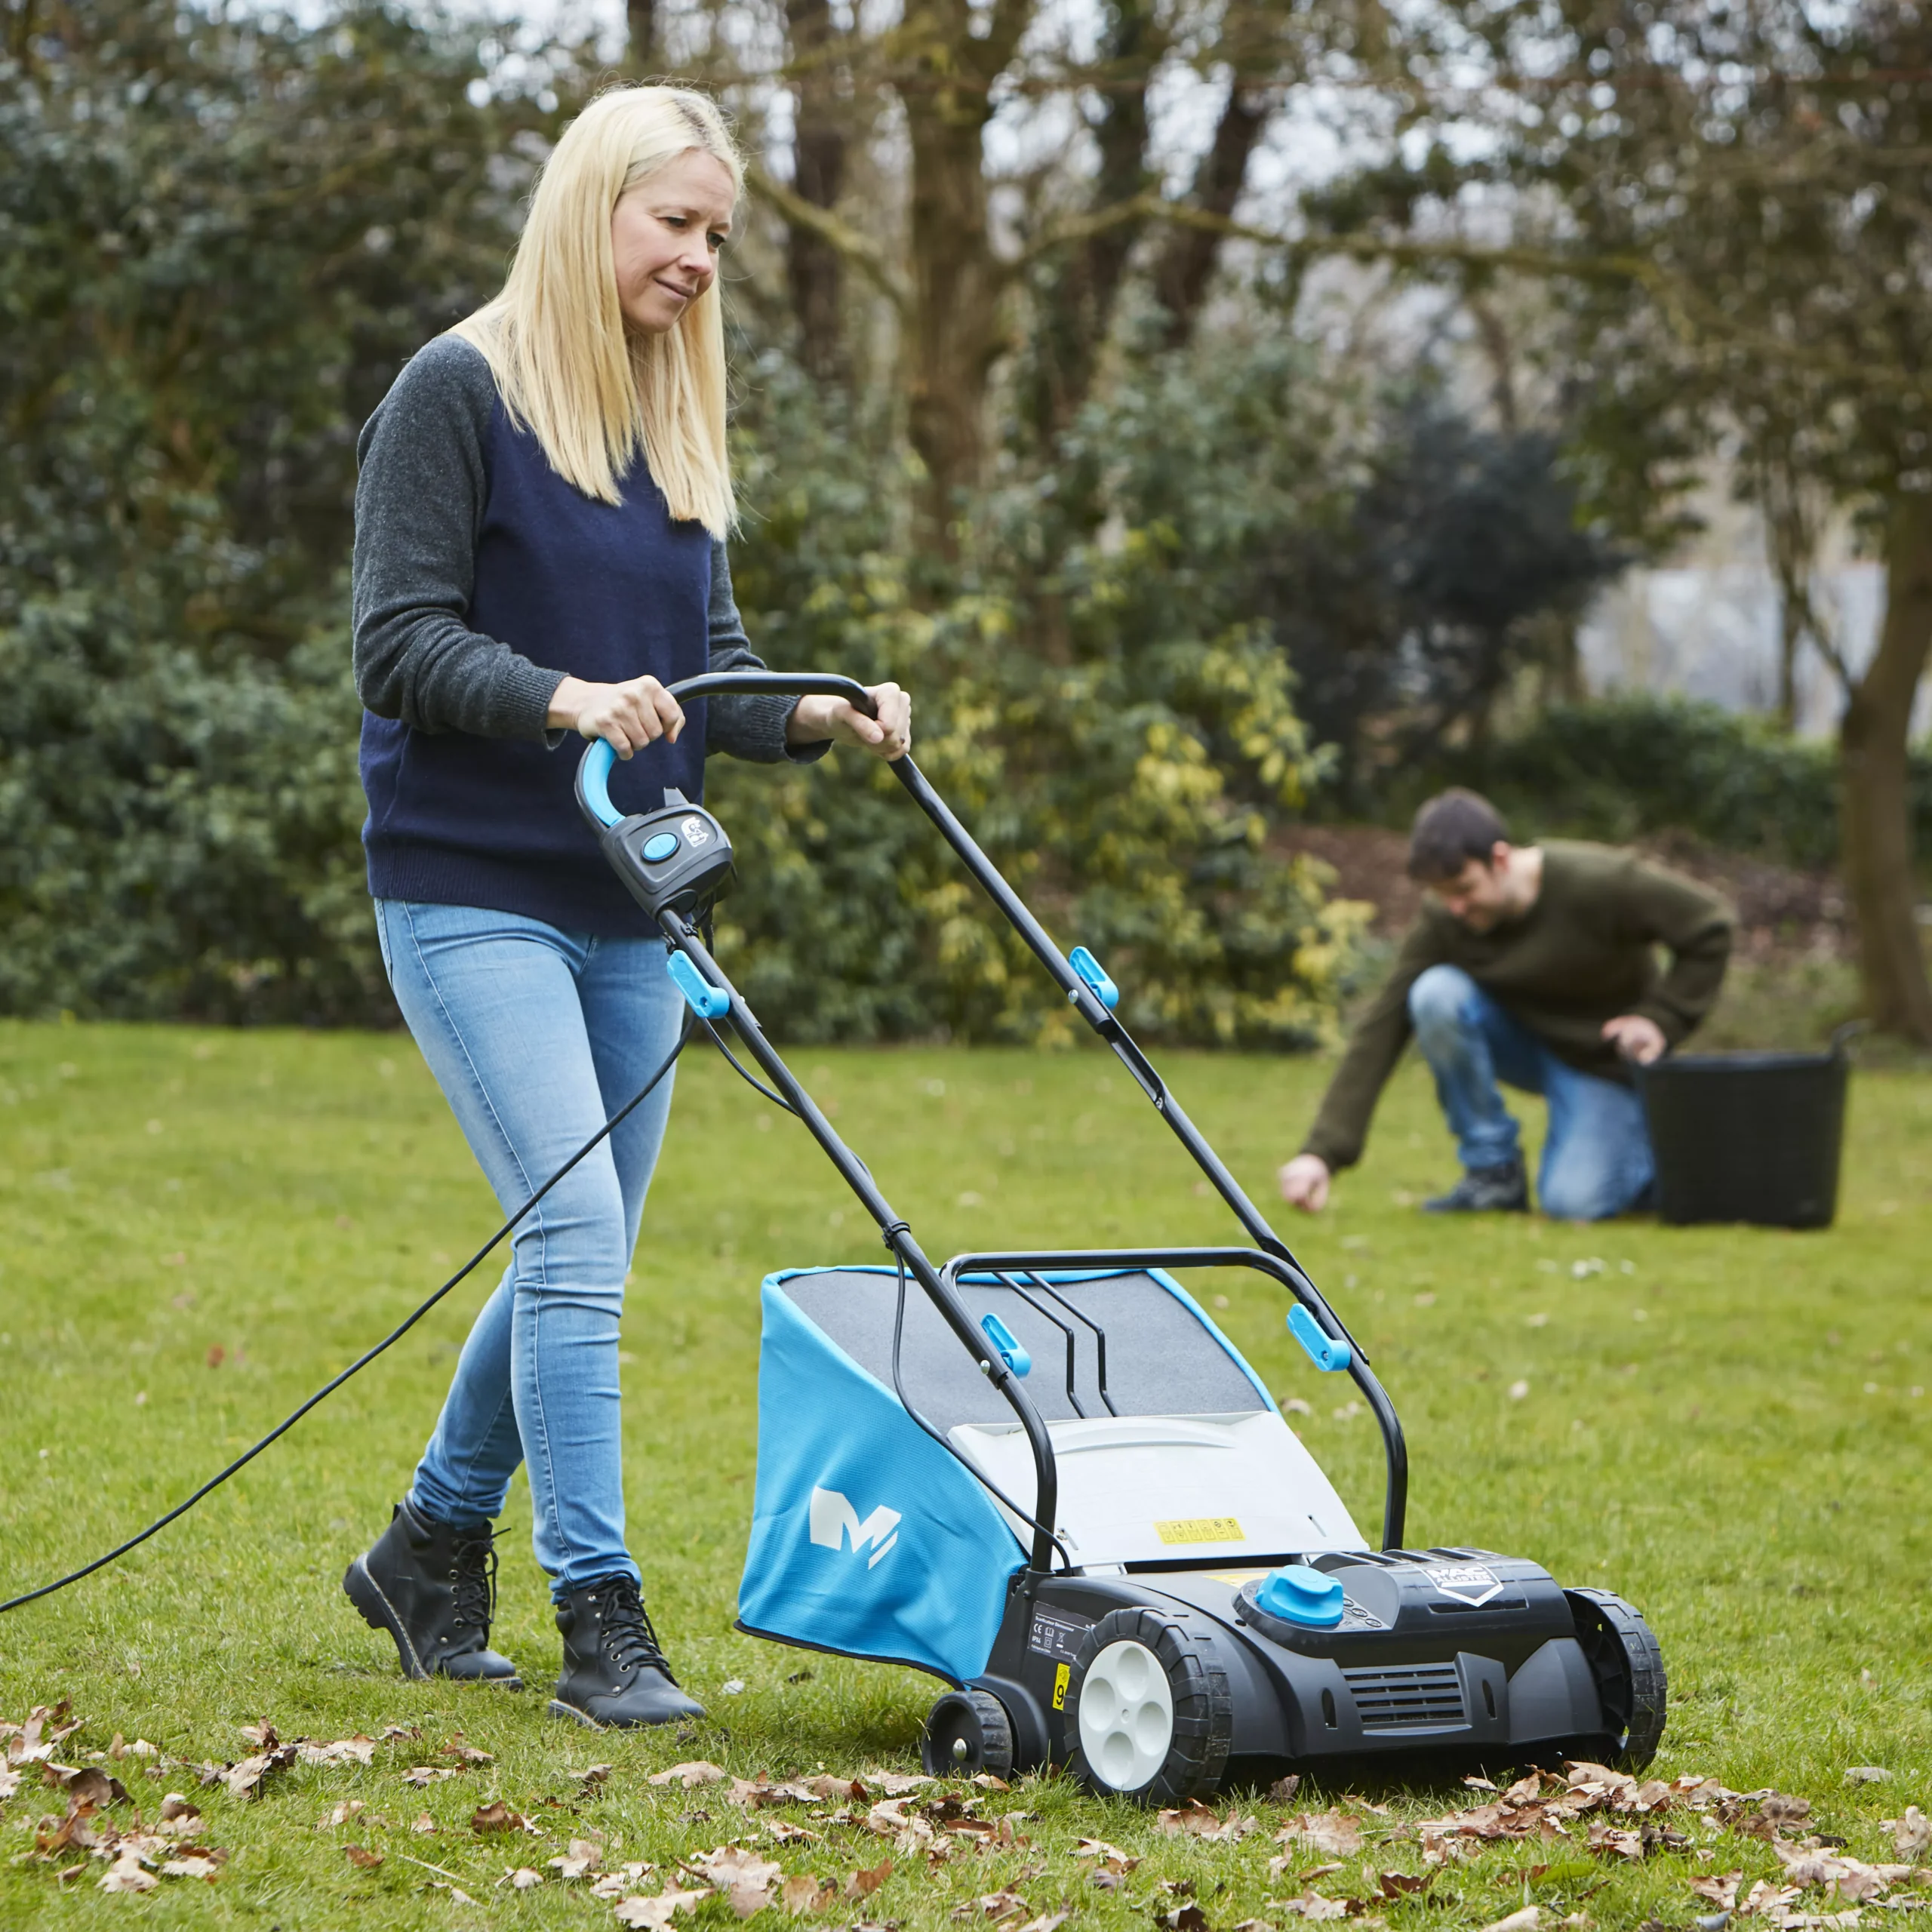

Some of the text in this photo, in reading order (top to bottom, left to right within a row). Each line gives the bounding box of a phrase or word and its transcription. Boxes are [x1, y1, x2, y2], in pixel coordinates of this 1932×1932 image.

[1426, 1567, 1487, 1578] MAC
[1437, 1574, 1491, 1583] ALLISTER
[1057, 1684, 1064, 1706] 9
